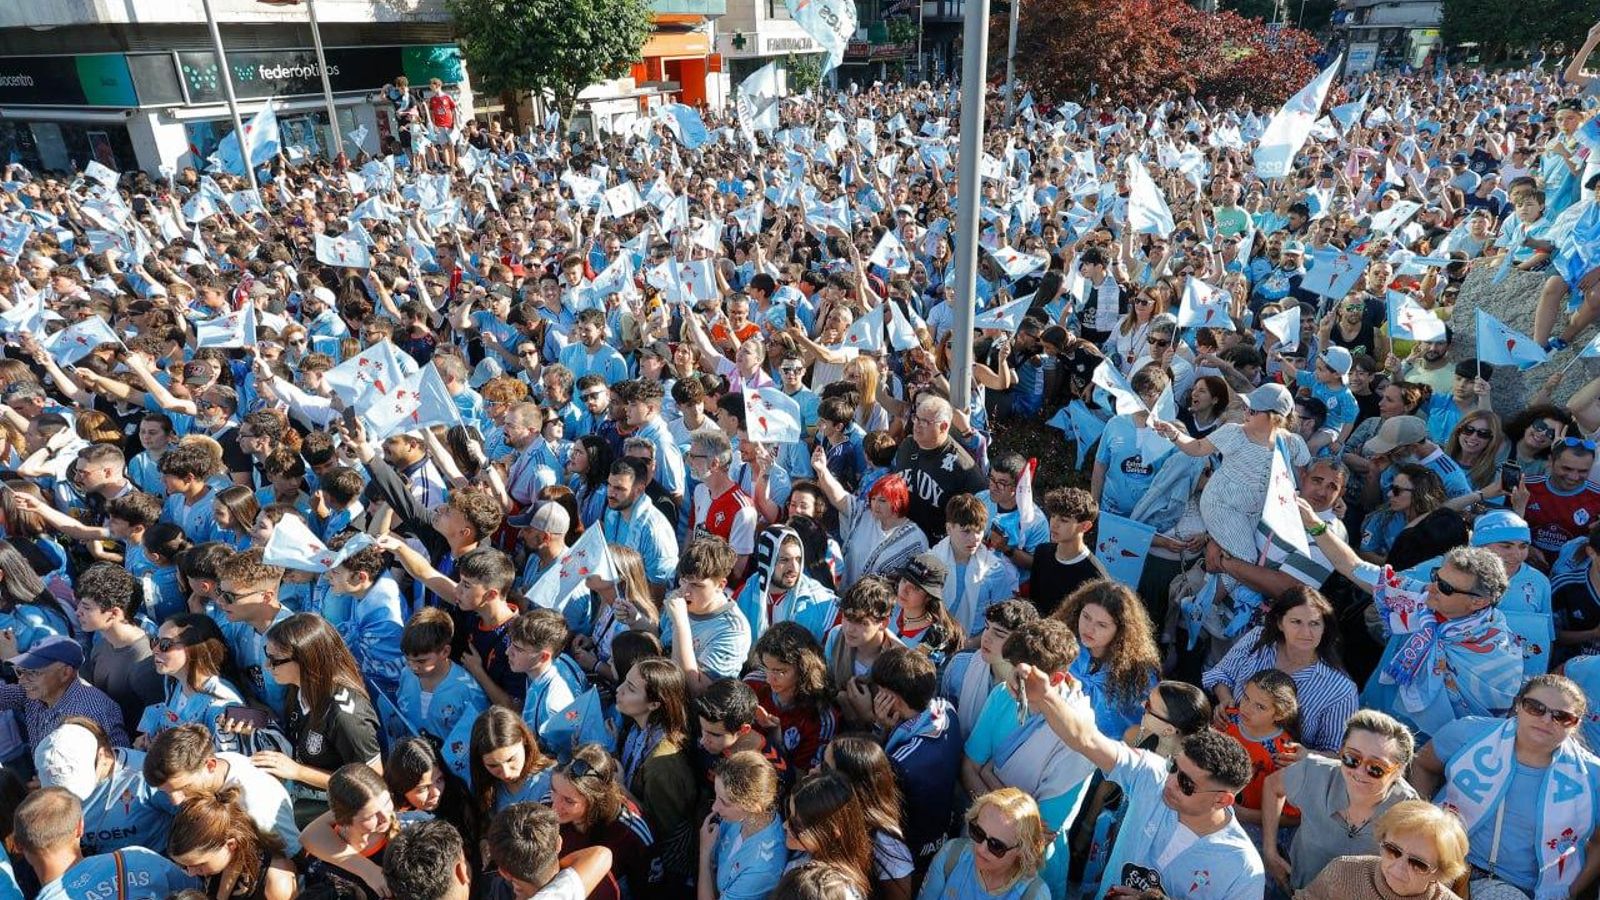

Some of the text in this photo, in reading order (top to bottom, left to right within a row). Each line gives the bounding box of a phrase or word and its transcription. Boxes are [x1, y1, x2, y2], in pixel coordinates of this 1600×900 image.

[767, 37, 813, 51] FARMACIA
[258, 62, 340, 80] federóptios
[1452, 745, 1503, 805] RC
[1551, 769, 1585, 804] A
